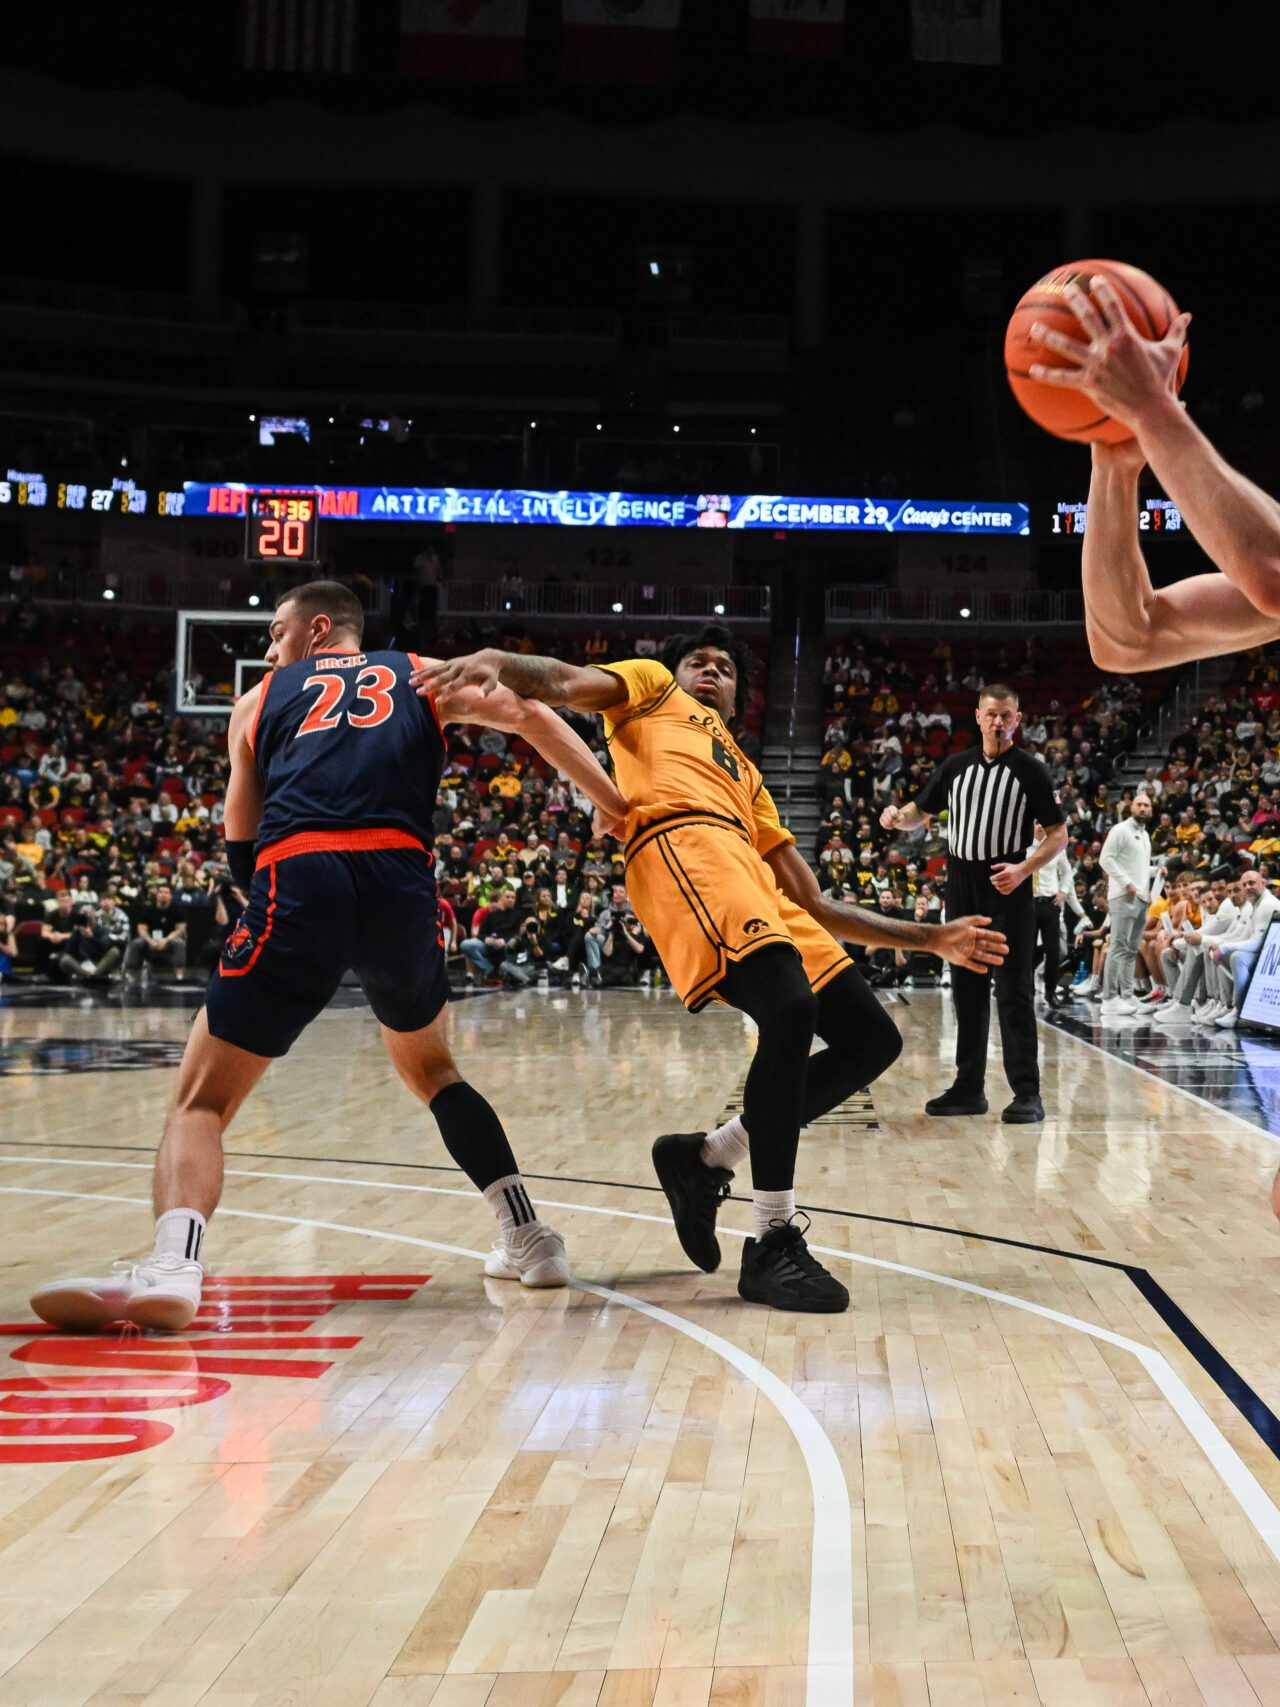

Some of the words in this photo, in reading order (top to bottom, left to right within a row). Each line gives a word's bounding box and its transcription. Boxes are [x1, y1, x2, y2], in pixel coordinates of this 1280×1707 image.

[91, 489, 113, 511] 27
[268, 499, 311, 521] 7:36
[372, 494, 511, 517] ARTIFICIAL
[522, 498, 685, 520] INTELLIGENCE
[744, 502, 859, 525] DECEMBER
[863, 504, 888, 526] 29
[902, 506, 949, 526] Casey's
[951, 508, 1011, 527] CENTER
[1052, 514, 1061, 533] 1
[1139, 511, 1151, 530] 2
[259, 521, 304, 556] 20
[295, 665, 397, 739] 23
